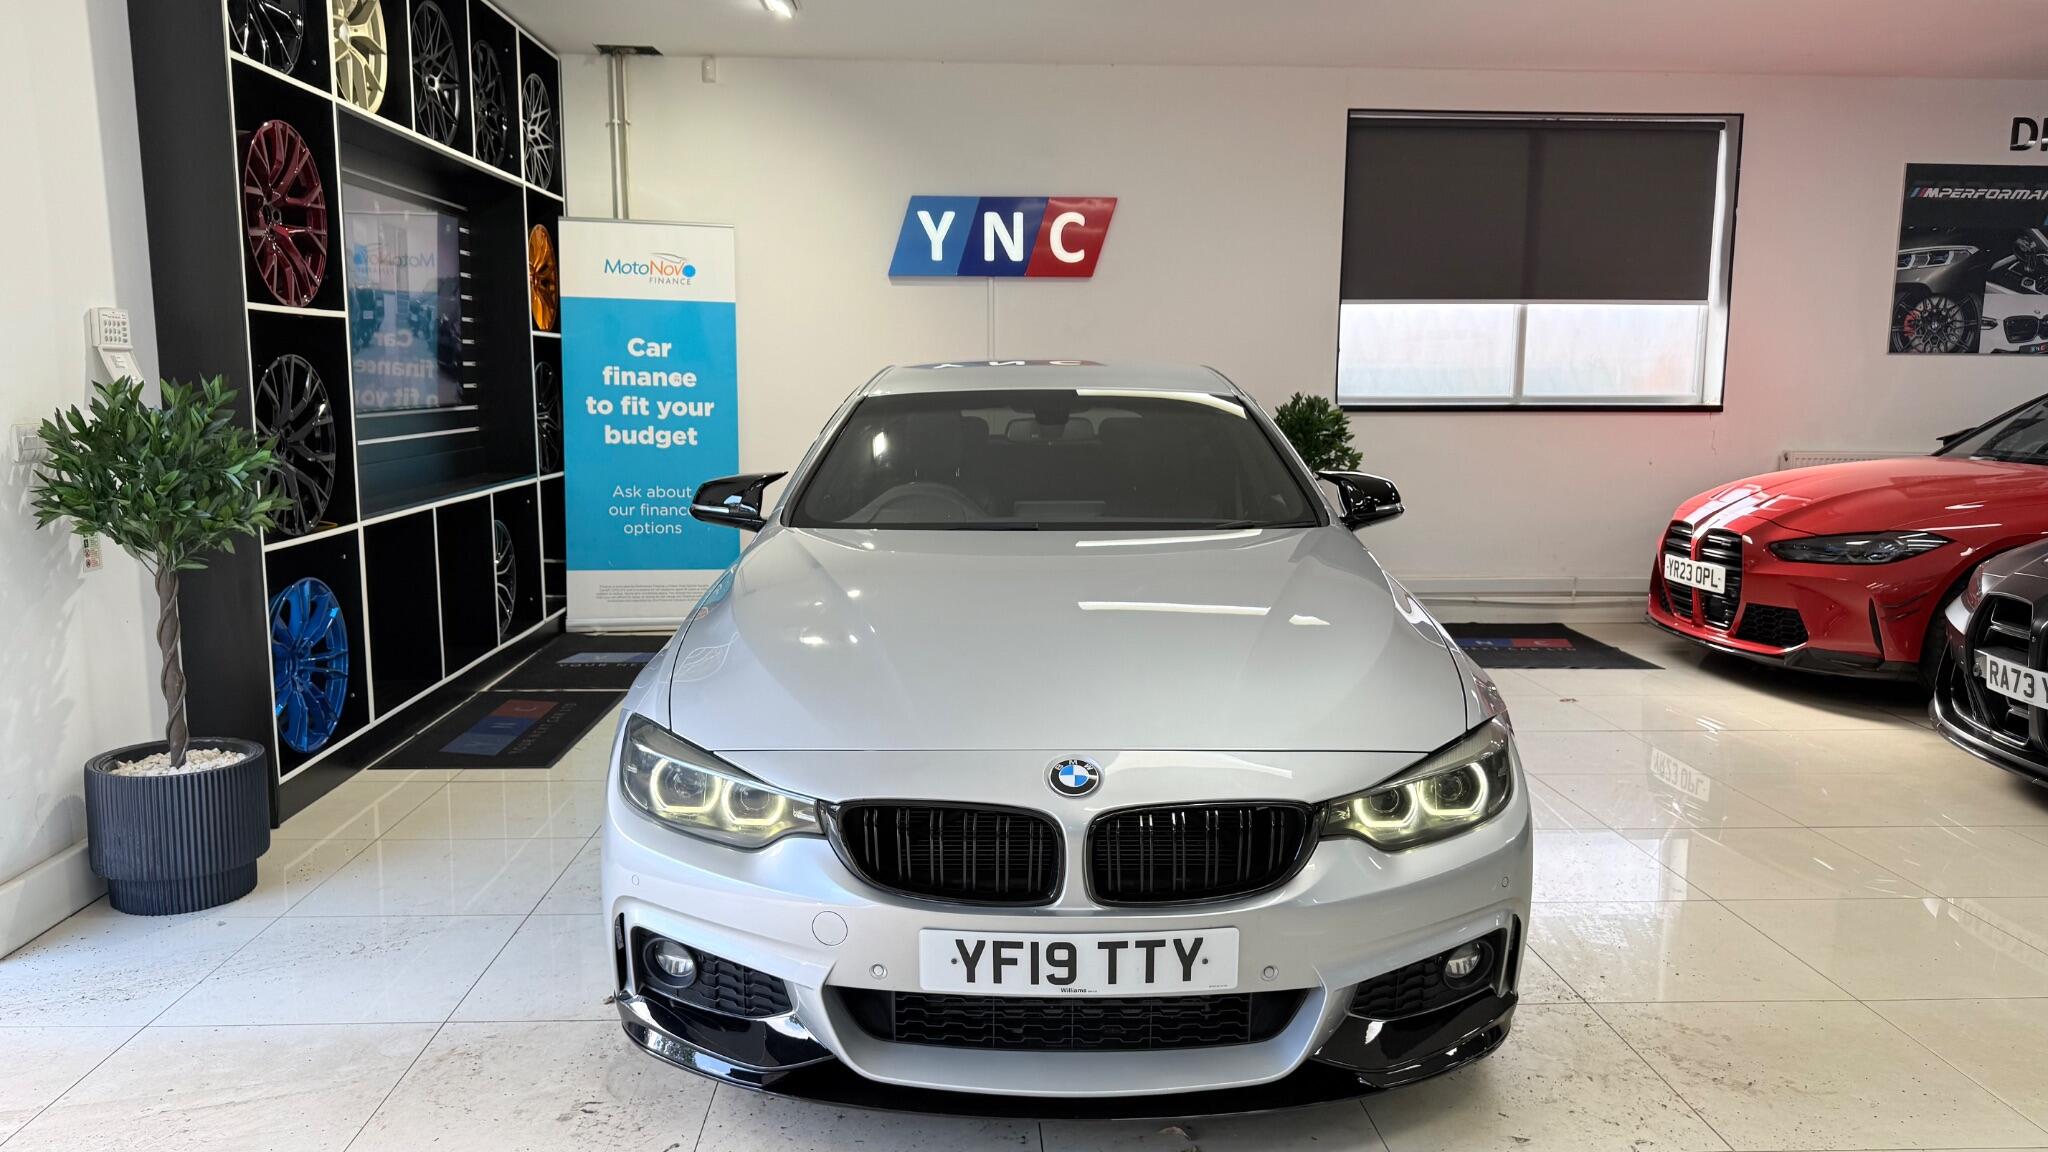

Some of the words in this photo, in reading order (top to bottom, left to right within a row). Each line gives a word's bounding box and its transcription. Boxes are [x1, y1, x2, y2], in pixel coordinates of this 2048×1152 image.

[917, 210, 1086, 263] YNC
[649, 276, 692, 286] FINANCE
[627, 337, 672, 358] Car
[602, 365, 698, 388] finance
[585, 396, 614, 415] to
[620, 395, 650, 416] fit
[656, 401, 716, 420] your
[604, 424, 699, 449] budget
[612, 485, 642, 498] Ask
[646, 485, 693, 498] about
[608, 505, 636, 517] our
[623, 521, 683, 536] options
[1668, 558, 1693, 582] YR23
[1695, 565, 1718, 588] OPL
[1990, 659, 2035, 699] RA73
[1054, 758, 1094, 771] BMW
[955, 938, 1078, 986] YF19
[1097, 937, 1204, 985] TTY
[1060, 986, 1088, 994] Williams
